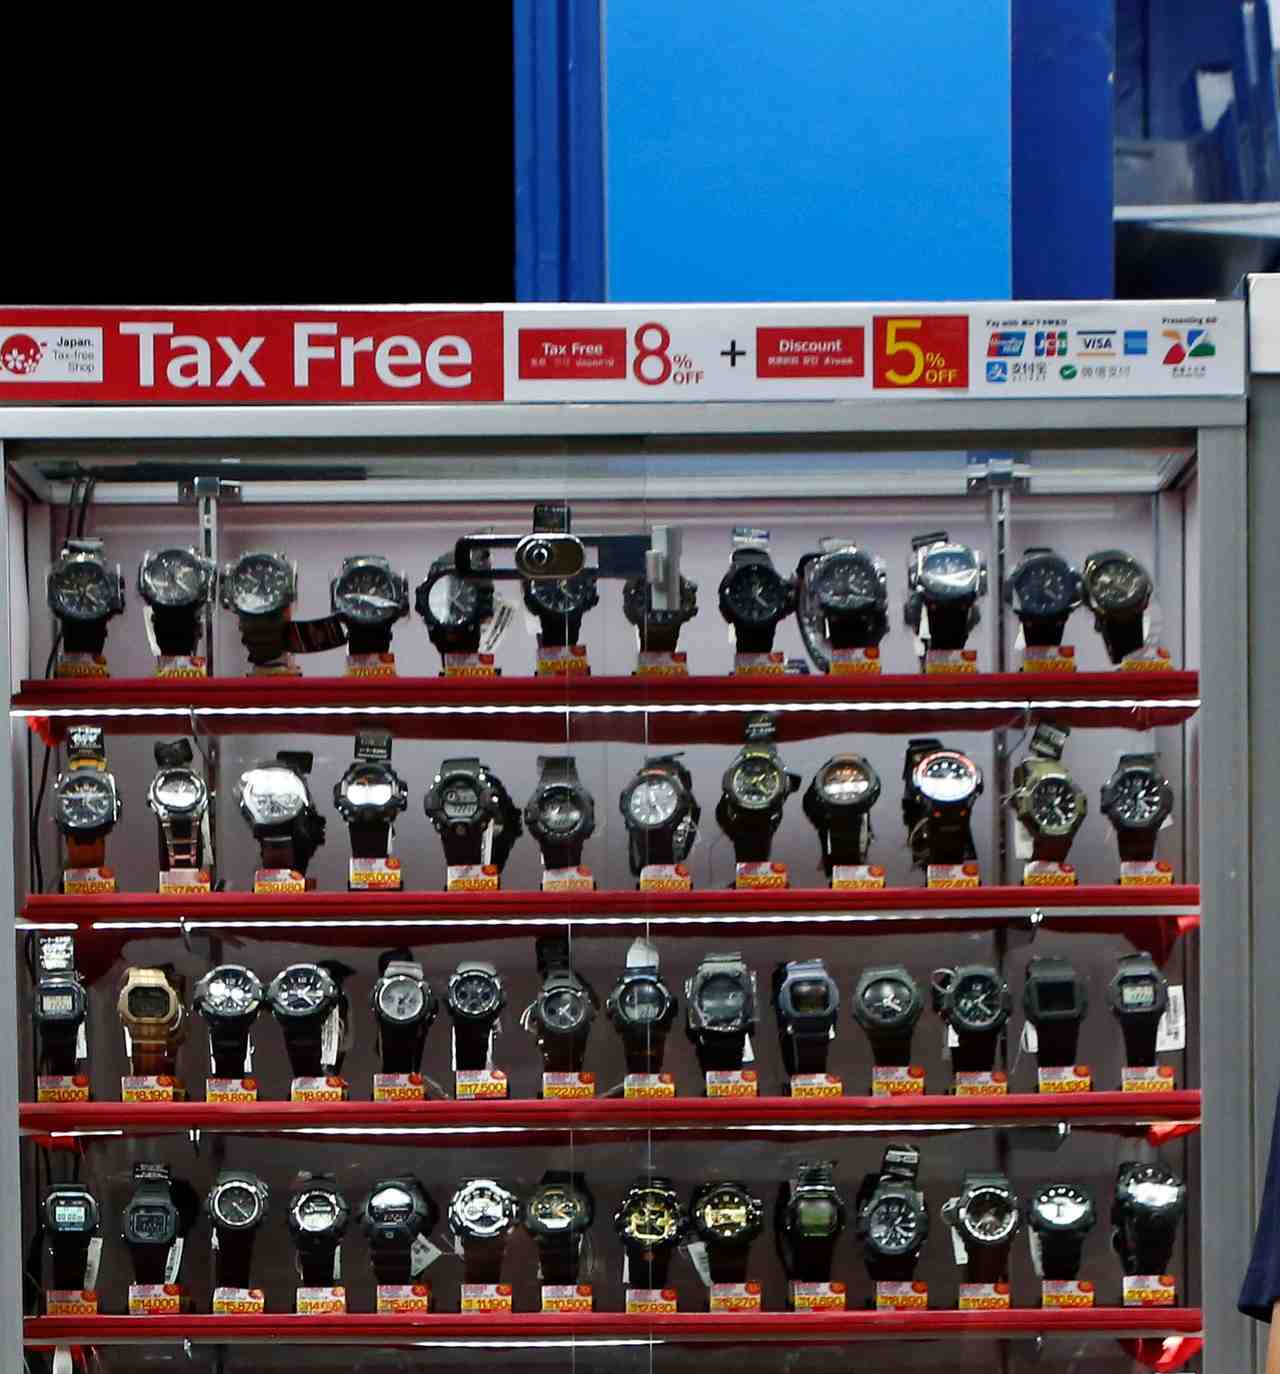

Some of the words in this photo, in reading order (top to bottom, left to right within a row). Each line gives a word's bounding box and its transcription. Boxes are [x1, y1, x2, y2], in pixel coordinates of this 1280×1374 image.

[542, 342, 567, 356] Tax
[571, 342, 603, 356] Free
[779, 339, 842, 353] Discount
[1083, 337, 1112, 350] VISA
[118, 321, 266, 388] Tax
[293, 322, 473, 388] Free
[632, 322, 673, 386] 8
[884, 319, 925, 386] 5
[68, 361, 95, 374] Shop
[672, 370, 704, 385] OFF
[925, 369, 957, 383] OFF
